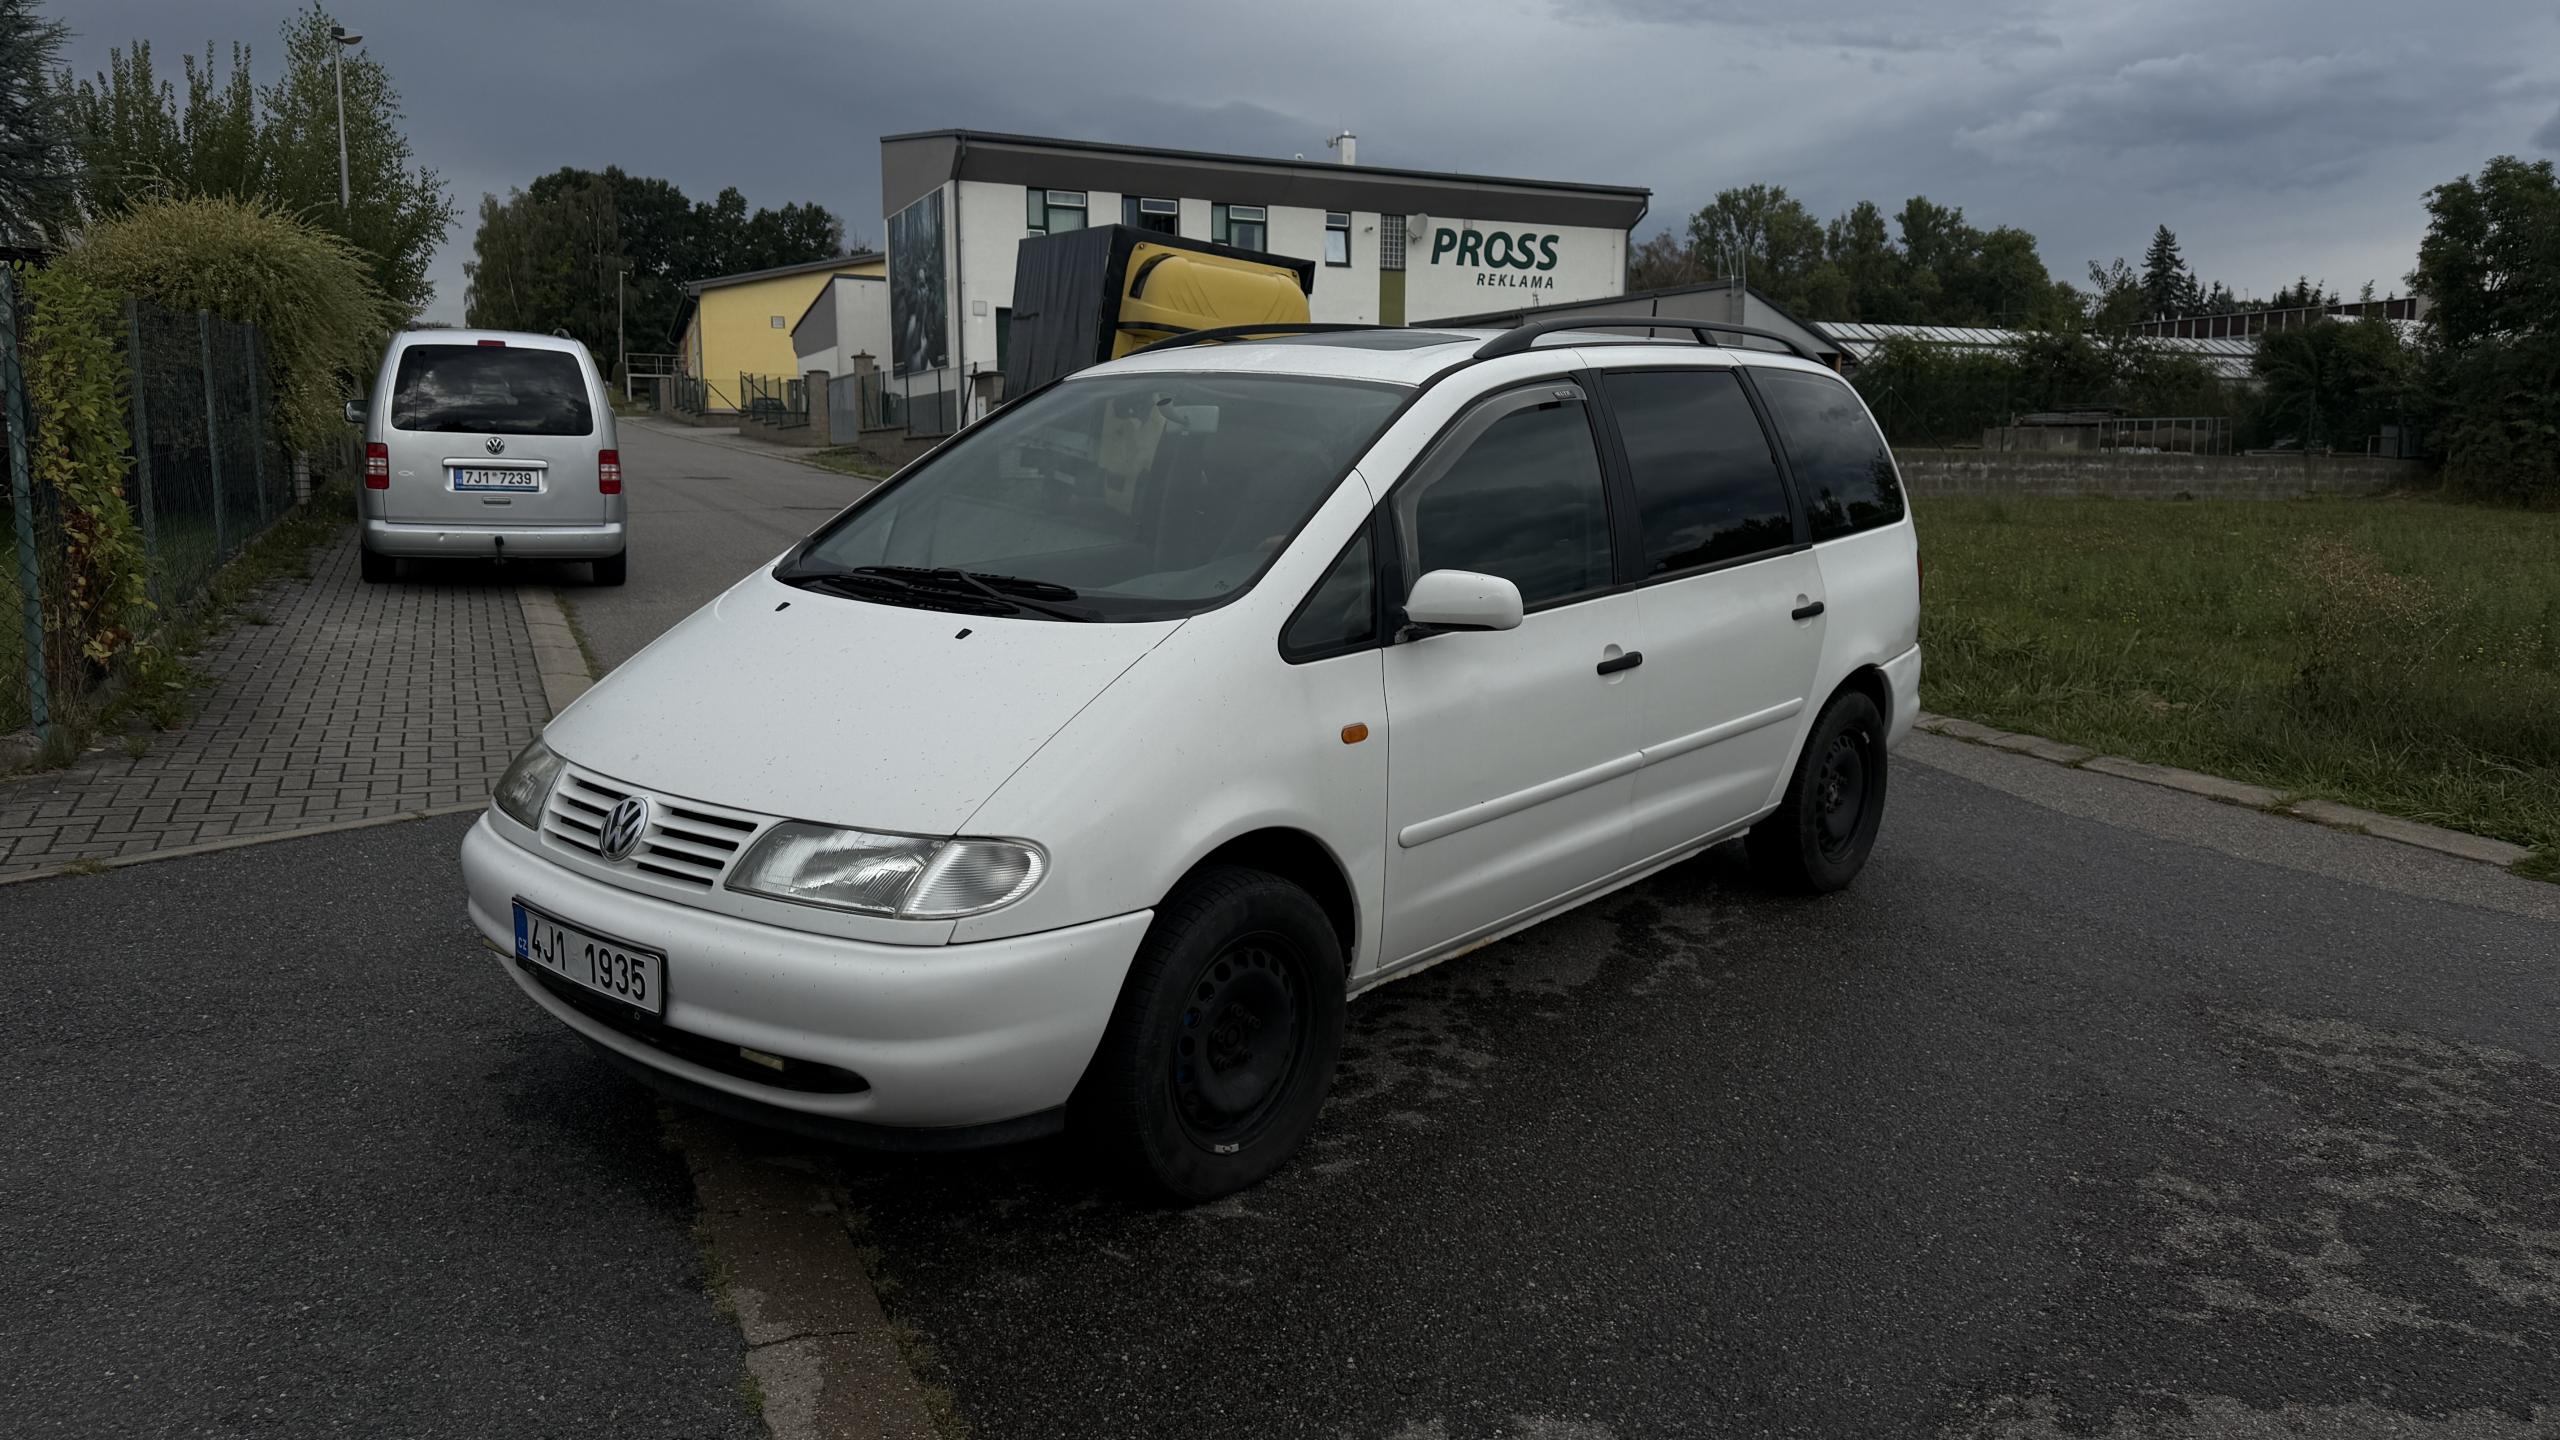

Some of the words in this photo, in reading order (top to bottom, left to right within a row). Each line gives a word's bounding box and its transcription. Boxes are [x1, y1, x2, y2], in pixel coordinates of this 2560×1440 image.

[1430, 227, 1560, 271] PROSS
[1476, 273, 1554, 289] REKLAMA
[465, 471, 489, 484] 7J1
[499, 472, 532, 485] 7239
[518, 937, 527, 951] CZ
[531, 918, 566, 971] 4J1
[584, 943, 646, 1000] 1935
